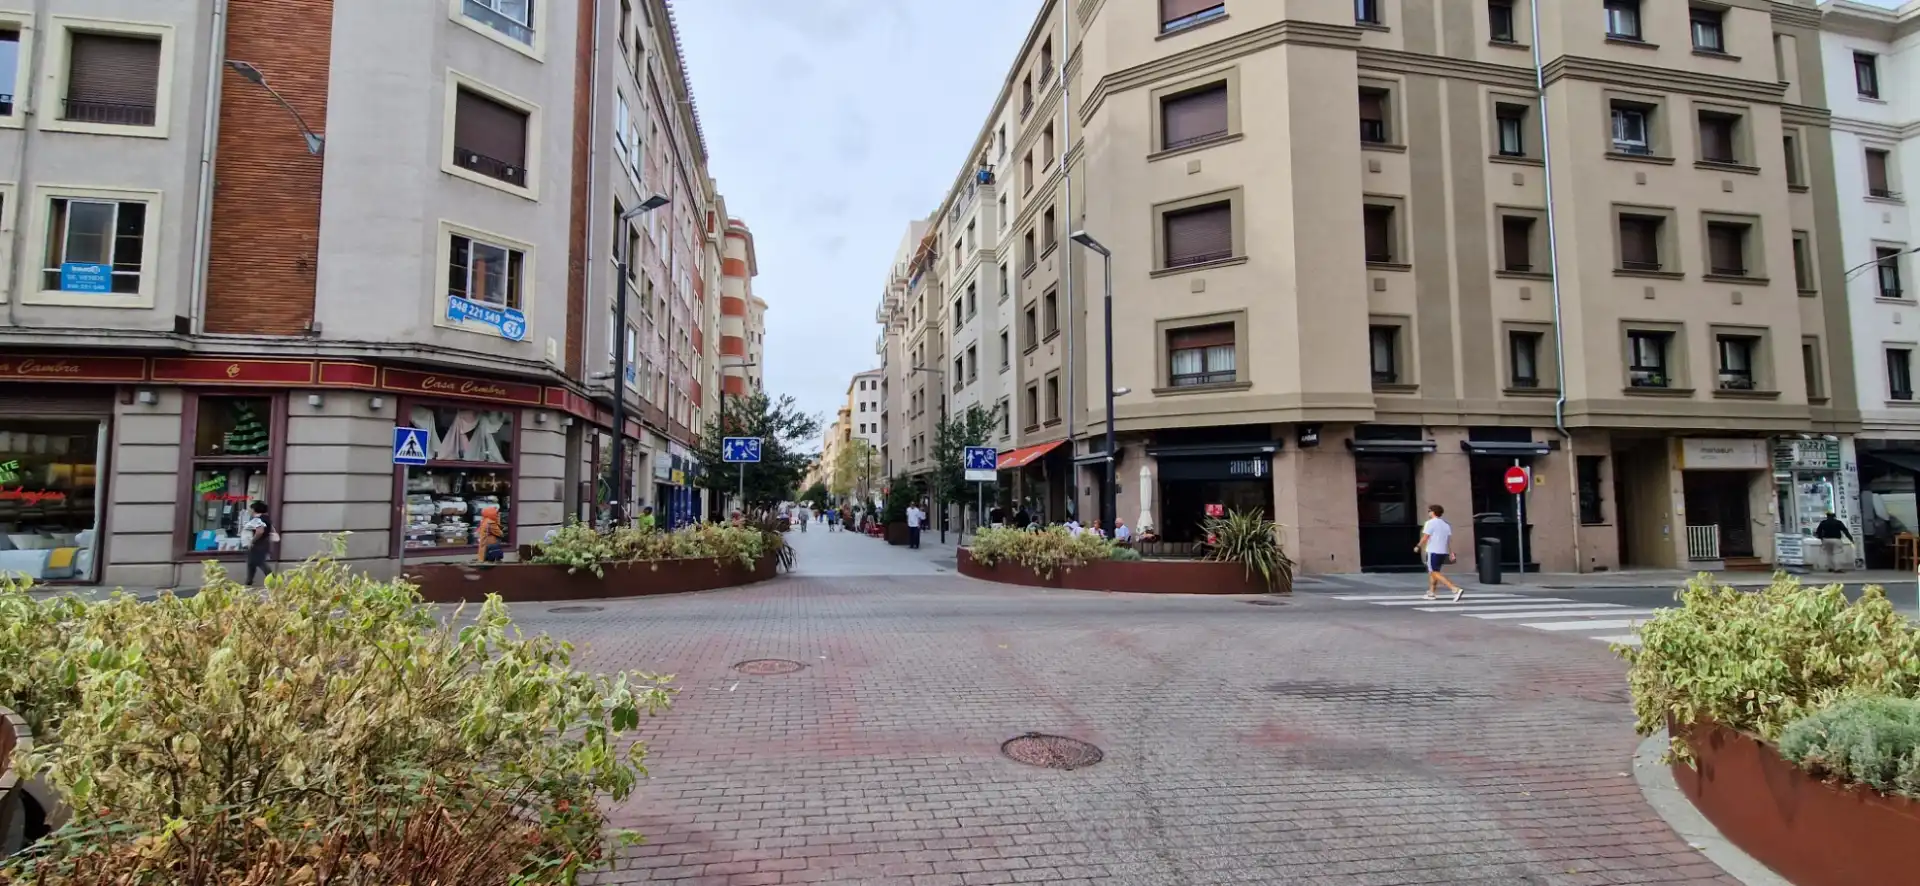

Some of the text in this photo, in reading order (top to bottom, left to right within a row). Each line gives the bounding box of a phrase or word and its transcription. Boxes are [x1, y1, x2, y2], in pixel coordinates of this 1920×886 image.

[451, 300, 468, 313] 948
[468, 305, 484, 319] 221
[17, 358, 81, 375] Cambra
[421, 376, 507, 396] Casa Cambra
